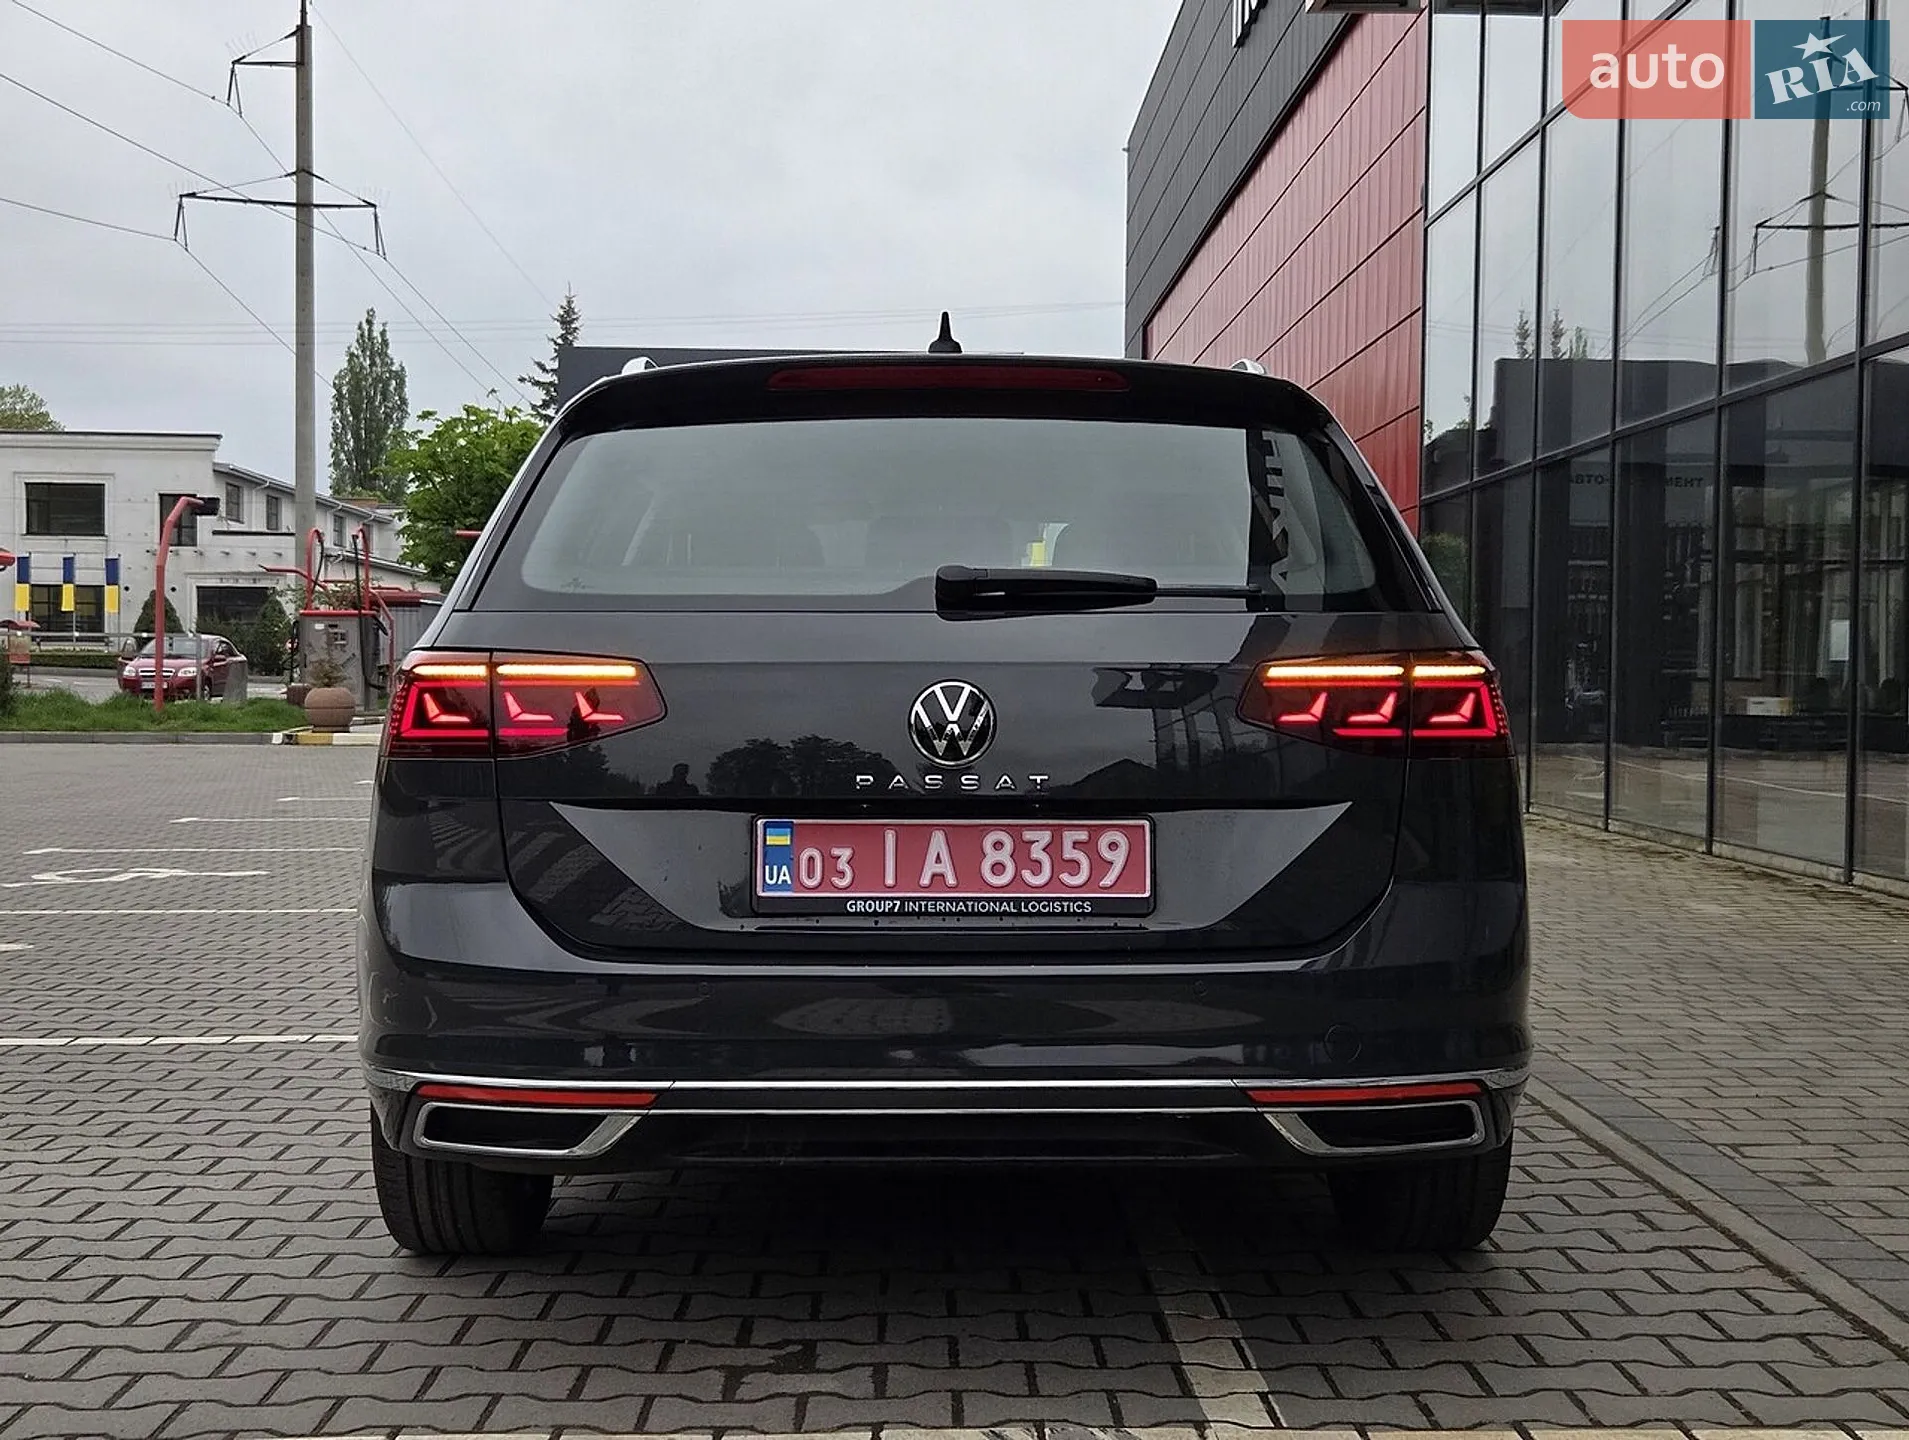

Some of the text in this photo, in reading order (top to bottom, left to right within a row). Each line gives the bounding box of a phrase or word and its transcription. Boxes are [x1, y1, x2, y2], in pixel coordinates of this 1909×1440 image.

[855, 774, 1050, 790] PASSAT
[799, 847, 855, 889] 03
[980, 829, 1131, 888] 8359
[764, 865, 792, 885] UA
[846, 900, 1093, 913] GROUP7 INTERNATIONAL LOGISTICS
